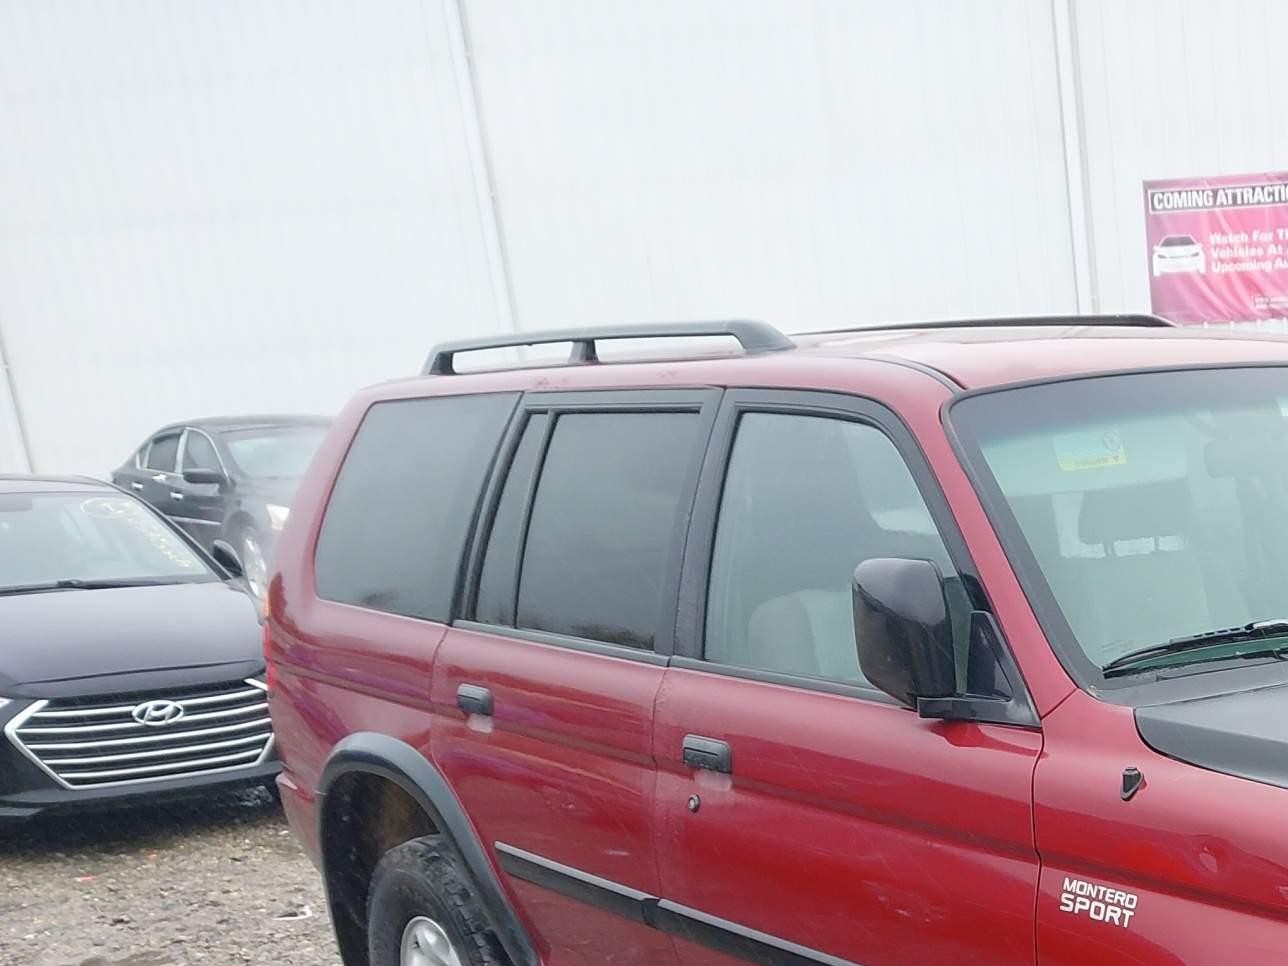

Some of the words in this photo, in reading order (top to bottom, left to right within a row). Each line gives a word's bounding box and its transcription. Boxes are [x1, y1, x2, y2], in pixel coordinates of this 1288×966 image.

[1153, 189, 1214, 209] COMING
[1210, 230, 1248, 244] Watch
[1252, 229, 1273, 242] For
[1212, 245, 1264, 258] Vehicles
[1267, 243, 1283, 255] At
[1212, 258, 1272, 273] Upcoming
[1063, 877, 1138, 909] MONTERO
[1060, 892, 1134, 928] SPORT
